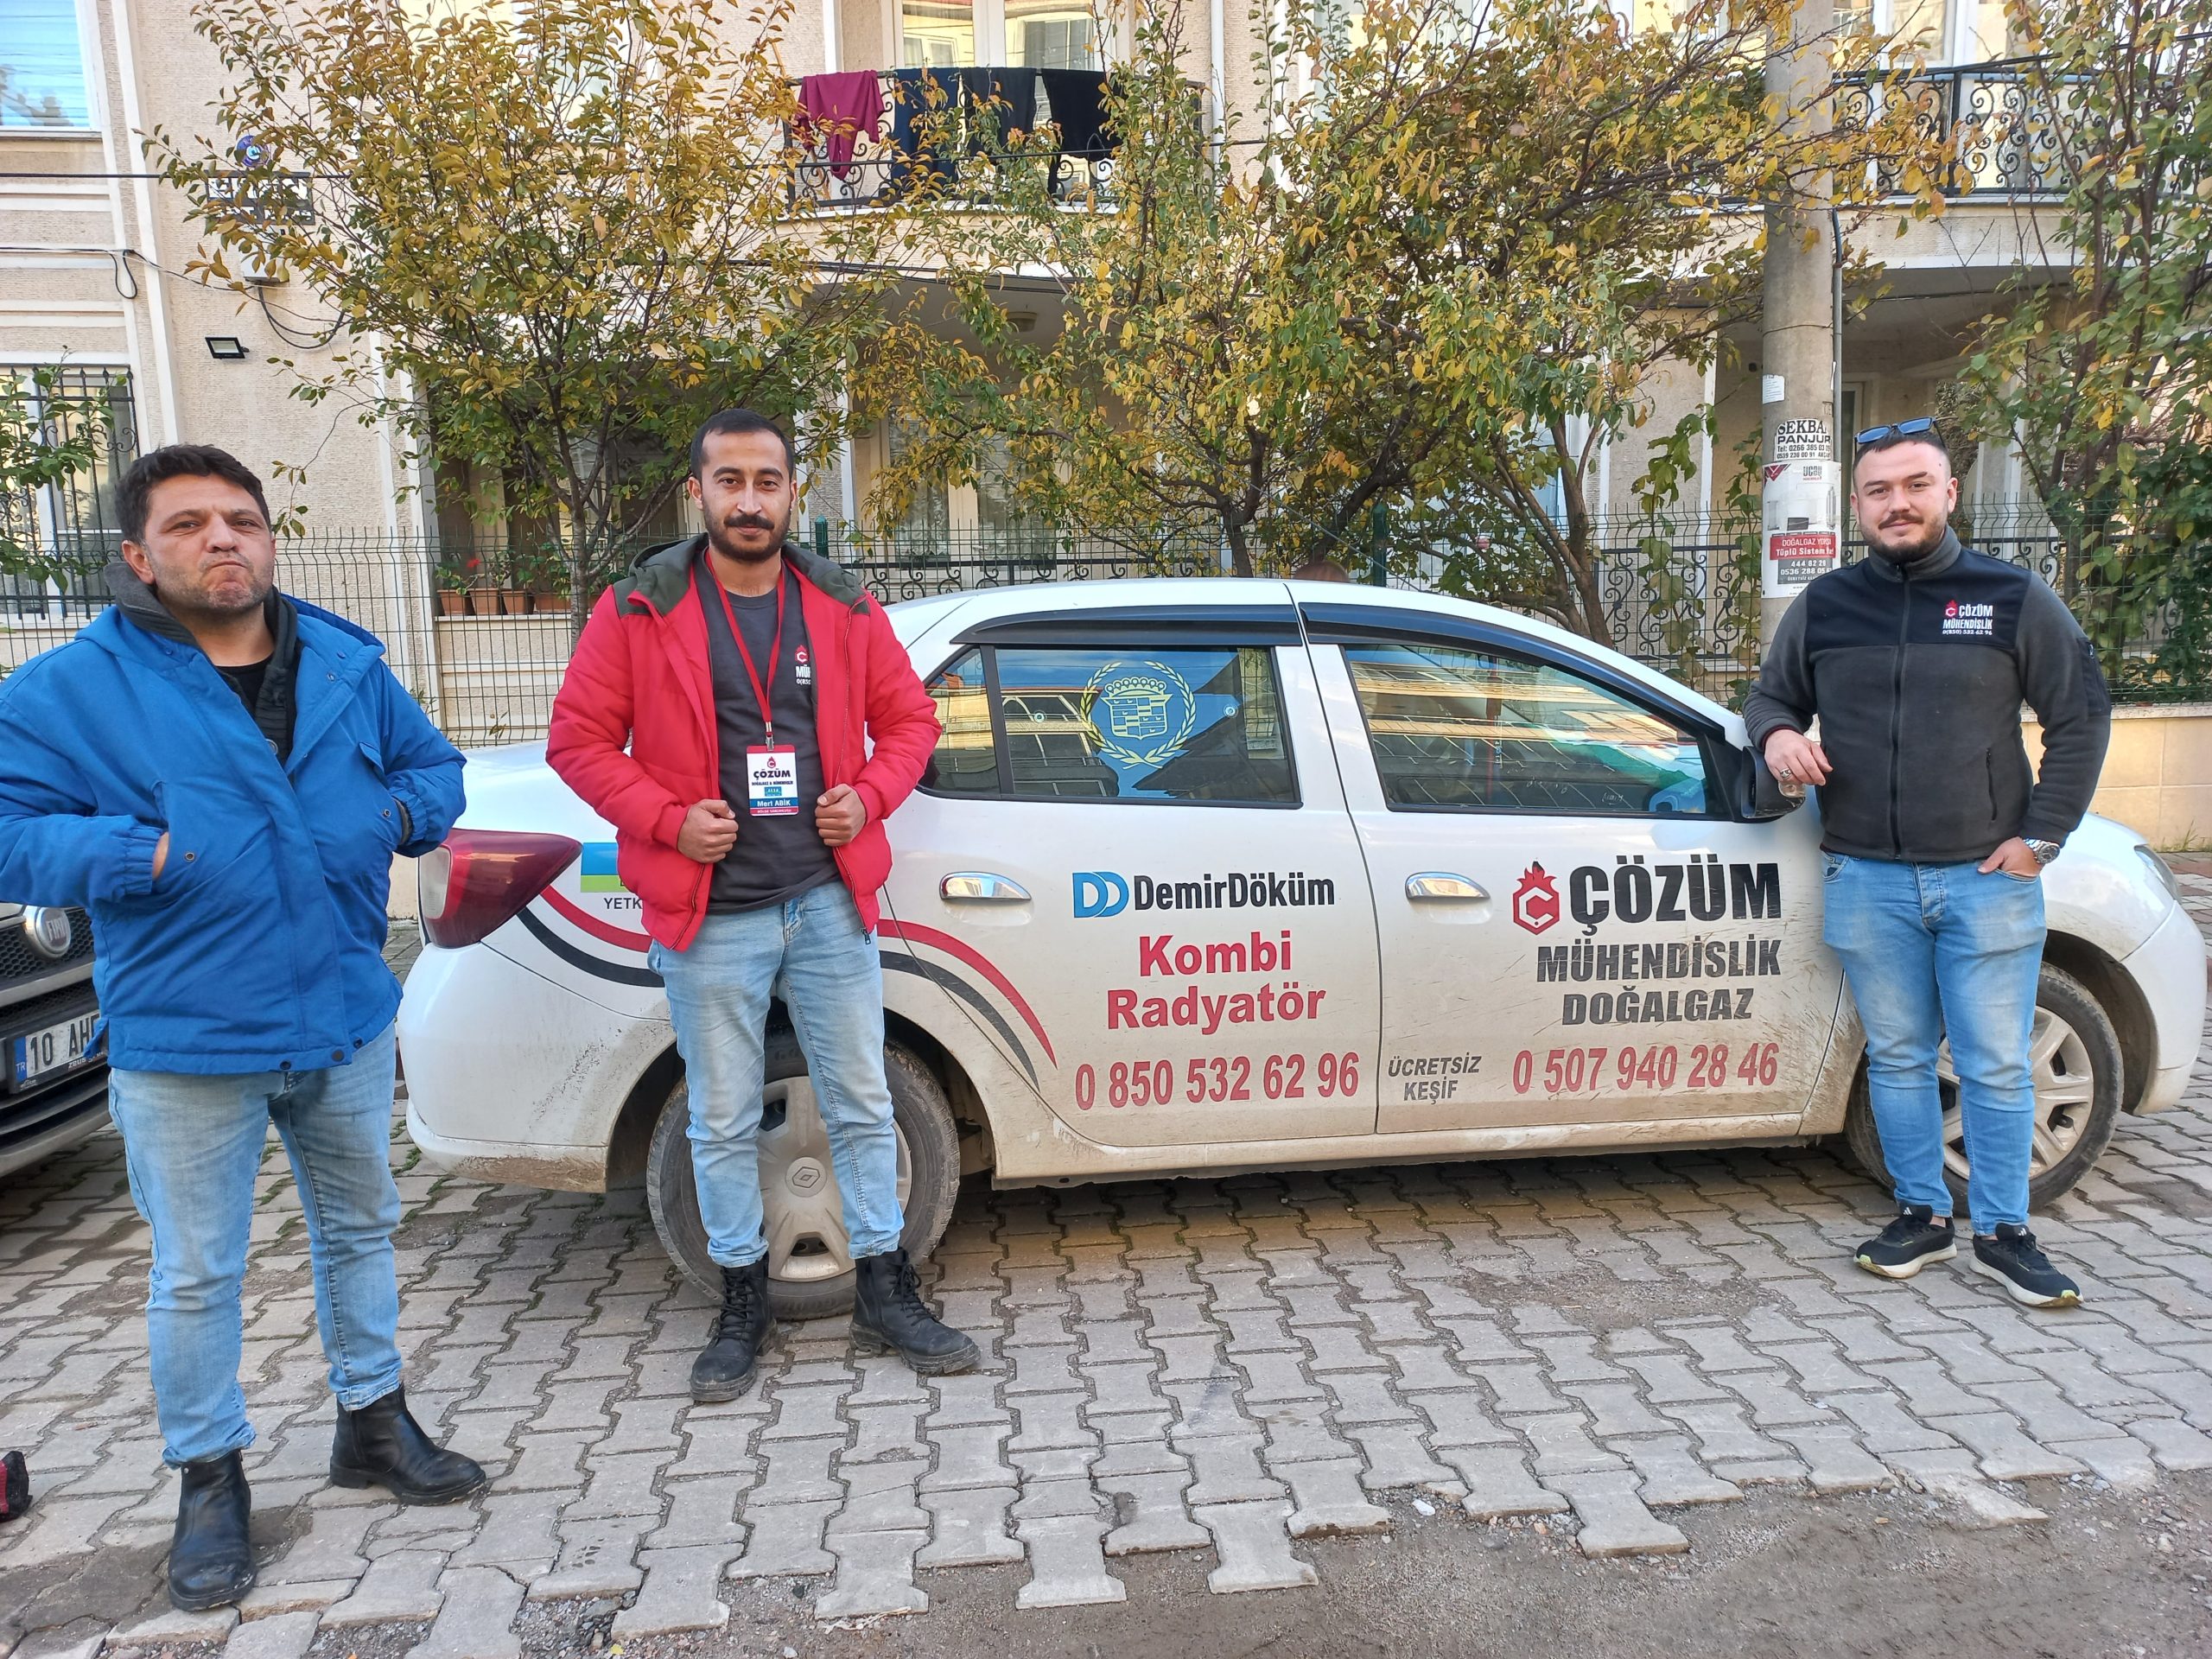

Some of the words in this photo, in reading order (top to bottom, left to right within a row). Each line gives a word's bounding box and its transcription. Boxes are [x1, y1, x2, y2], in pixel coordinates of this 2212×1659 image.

[1777, 420, 1827, 435] SEKBA
[1777, 435, 1830, 444] PANJUR
[1776, 548, 1797, 557] Tüplü
[1783, 537, 1816, 546] DOĞALGAZ
[1942, 618, 1993, 629] MÜHENDİSLİK
[1959, 604, 1993, 618] ÇÖZÜM
[753, 768, 791, 780] ÇÖZÜM
[604, 898, 643, 910] YETK
[1134, 872, 1335, 910] DemirDöküm
[1569, 854, 1783, 936] ÇÖZÜM
[1139, 931, 1292, 976] Kombi
[1536, 934, 1783, 982] MÜHENDİSLİK
[1107, 982, 1326, 1035] Radyatör
[1562, 986, 1755, 1026] DOĞALGAZ
[30, 1032, 54, 1071] 10
[1388, 1052, 1482, 1077] ÜCRETSİZ
[16, 1062, 26, 1072] TR
[1512, 1050, 1533, 1094] 0
[1543, 1047, 1608, 1092] 507
[1617, 1046, 1679, 1090] 940
[1688, 1044, 1729, 1088] 28
[1737, 1042, 1780, 1086] 46
[1075, 1064, 1096, 1110] 0
[1109, 1060, 1173, 1108] 850
[1186, 1056, 1250, 1103] 532
[1263, 1053, 1306, 1099] 62
[1318, 1052, 1359, 1097] 96
[1403, 1077, 1459, 1105] KEŞİF
